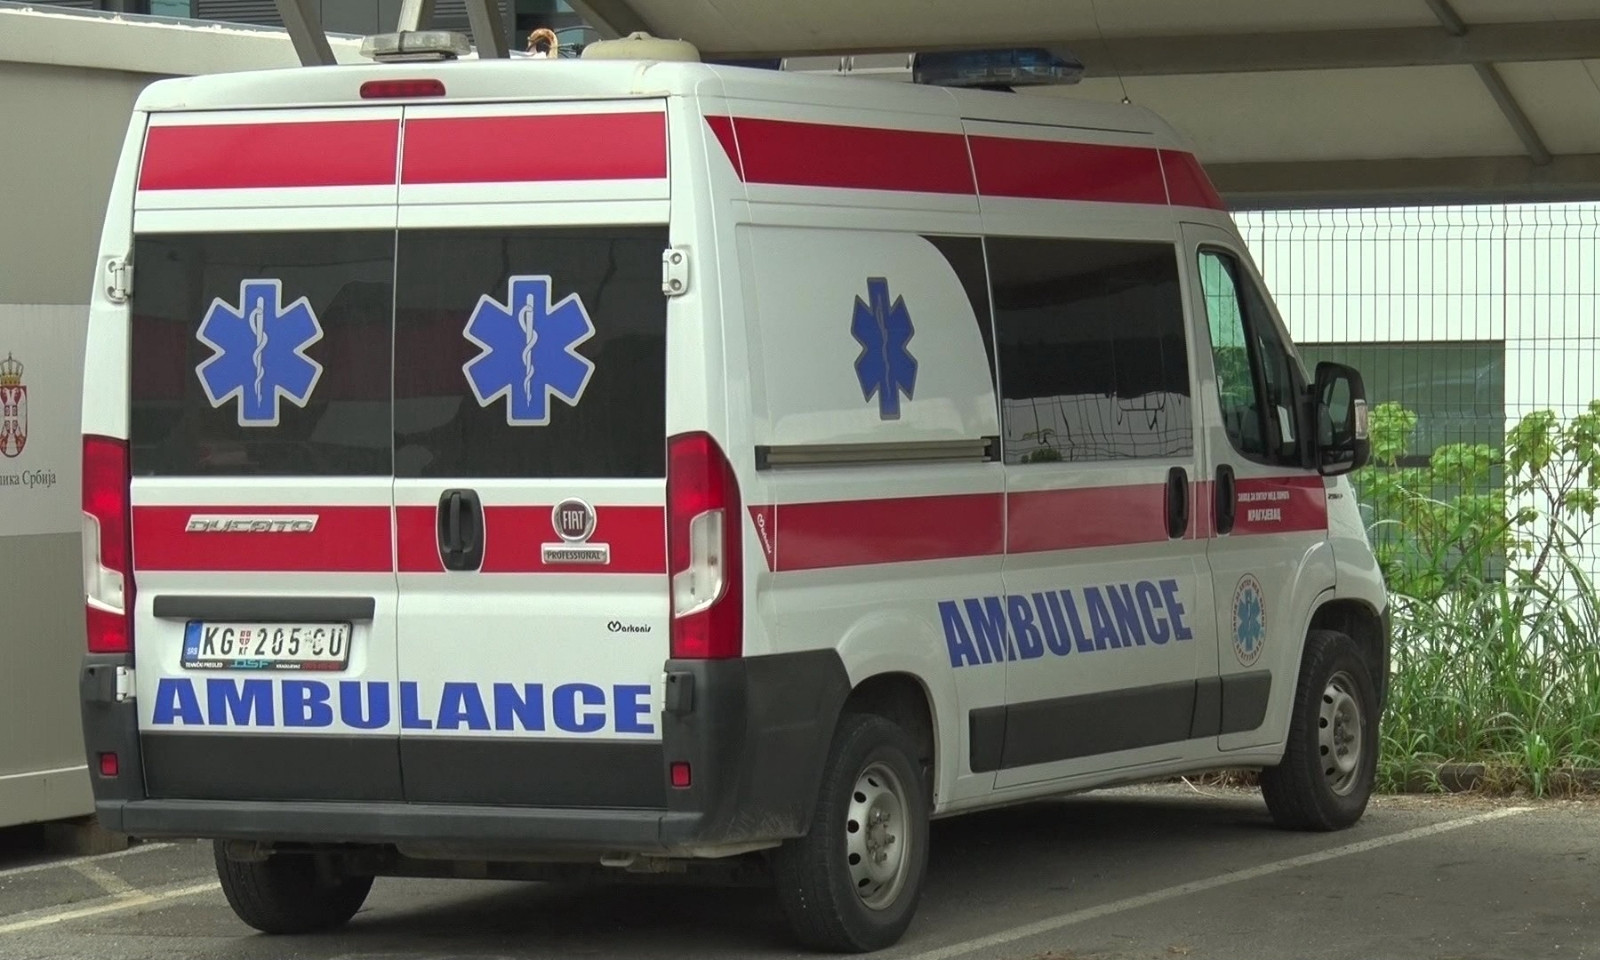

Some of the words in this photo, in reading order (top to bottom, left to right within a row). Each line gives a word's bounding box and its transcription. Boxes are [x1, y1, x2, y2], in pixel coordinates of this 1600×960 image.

[22, 469, 57, 489] Србија
[562, 510, 585, 530] FIAT
[546, 550, 601, 560] PROFESSIONAL
[938, 579, 1193, 668] AMBULANCE
[203, 627, 235, 656] KG
[254, 627, 302, 656] 205
[152, 678, 655, 733] AMBULANCE
